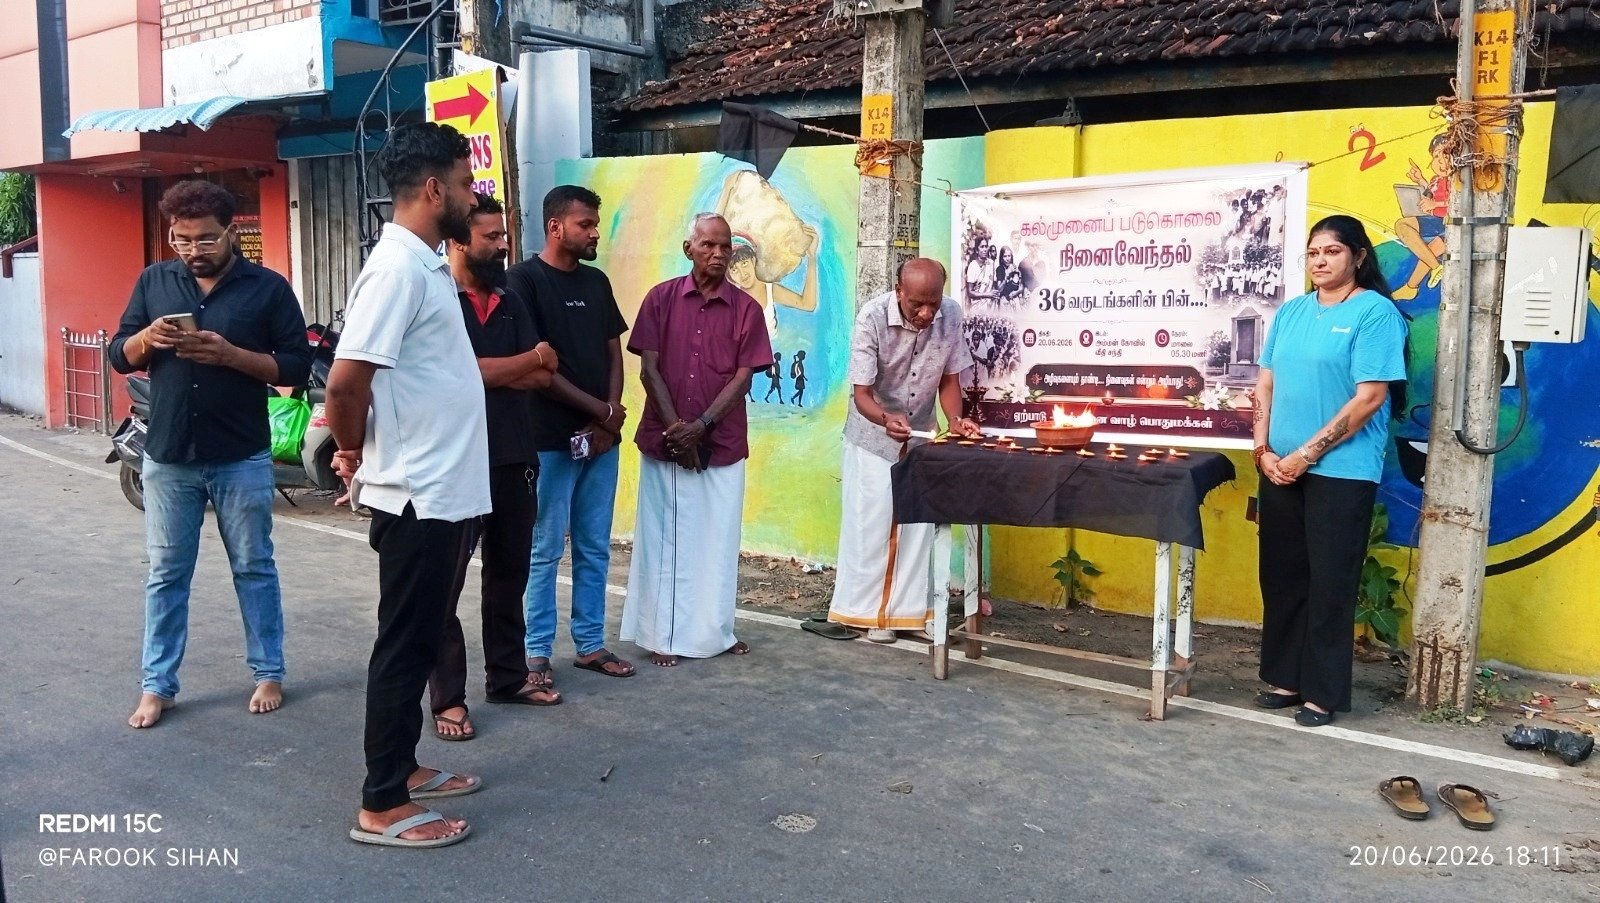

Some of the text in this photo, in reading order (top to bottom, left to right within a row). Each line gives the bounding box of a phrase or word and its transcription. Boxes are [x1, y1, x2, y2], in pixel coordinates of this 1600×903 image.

[1474, 29, 1509, 46] K14
[1478, 50, 1499, 66] F1
[1477, 69, 1499, 84] RK
[867, 107, 890, 120] K14
[871, 122, 885, 135] F2
[1348, 130, 1386, 171] 2
[1020, 209, 1222, 241] கல்முனைப் படுகொலை
[1059, 237, 1193, 275] நினைவேந்தல்
[1038, 287, 1066, 312] 36
[1068, 289, 1157, 313] வருடங்களின்
[1038, 338, 1073, 347] 20.06.2026
[1170, 349, 1191, 358] 05.30
[1013, 409, 1047, 423] ஏற்பாடு
[1110, 414, 1137, 428] வாழ்
[1139, 415, 1214, 430] பொதுமக்கள்
